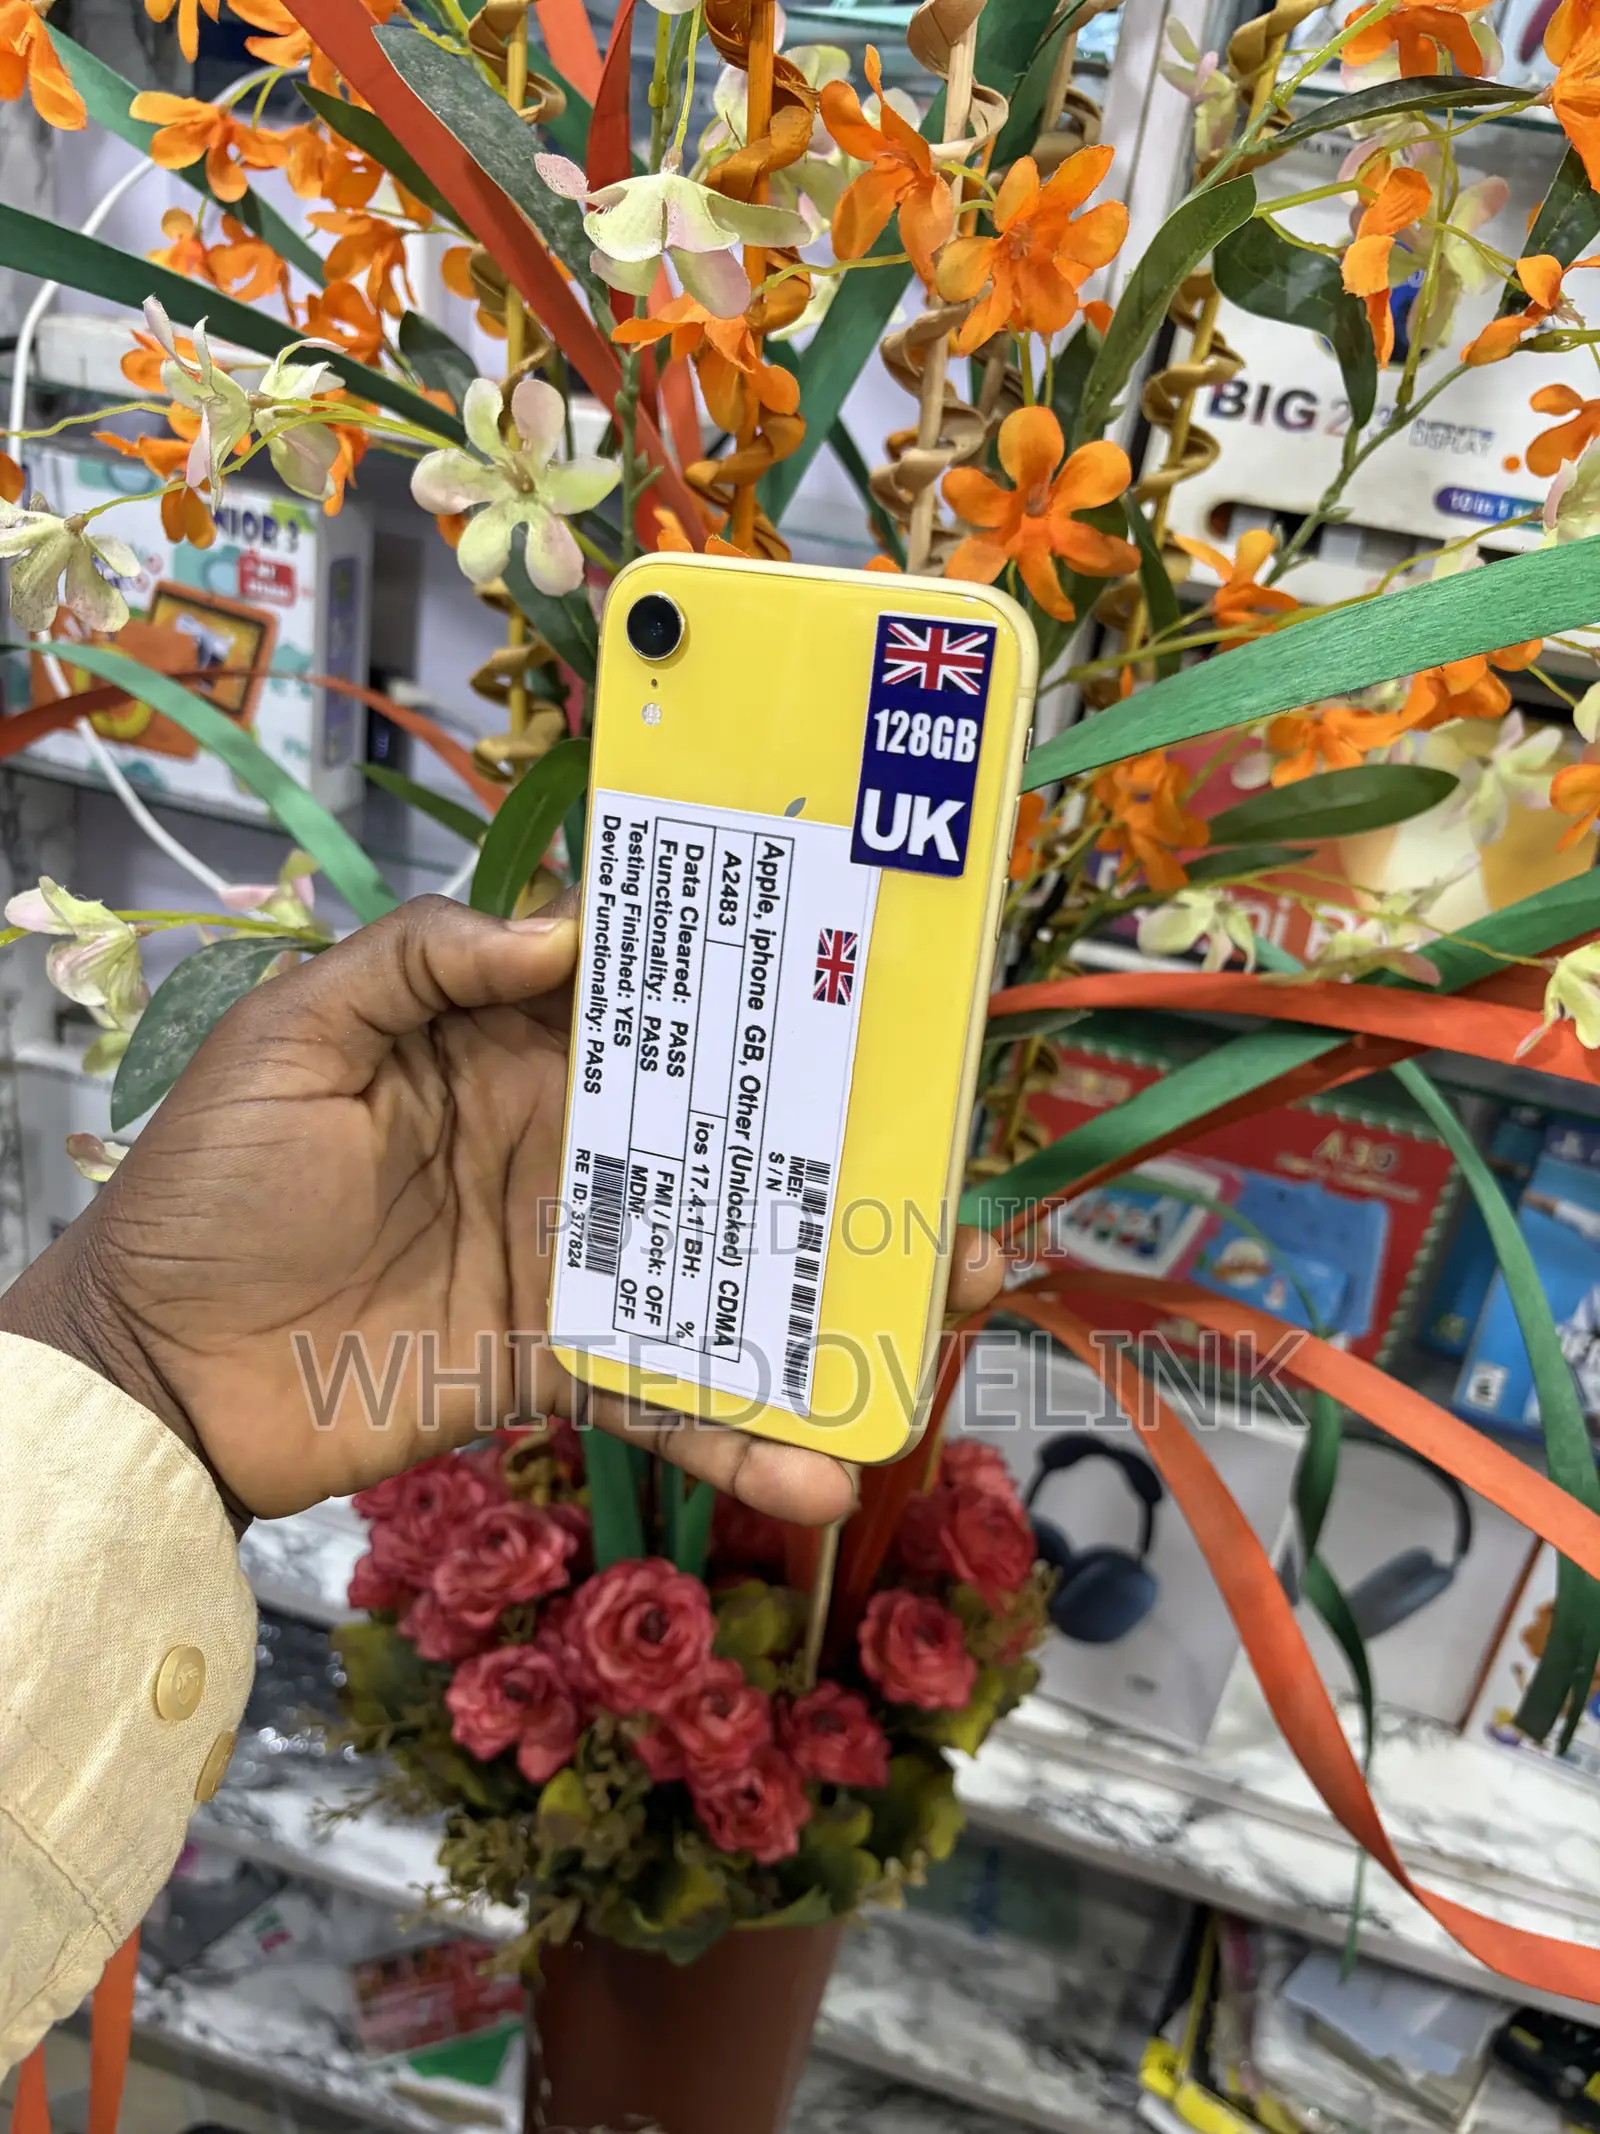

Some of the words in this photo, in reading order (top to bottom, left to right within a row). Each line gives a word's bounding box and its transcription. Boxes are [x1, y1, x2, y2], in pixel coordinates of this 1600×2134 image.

[1207, 378, 1319, 433] BIG
[874, 707, 978, 764] 128GB
[598, 814, 622, 886] Device
[860, 787, 966, 863] UK
[620, 819, 649, 897] Testing
[681, 843, 705, 898] Data
[753, 841, 786, 920] Apple,
[717, 850, 742, 927] A2483
[644, 839, 679, 1002] Functionality:
[584, 892, 616, 1033] Functionality:
[617, 902, 642, 999] Finished:
[672, 906, 700, 1004] Cleared:
[747, 927, 777, 1011] iphone
[613, 1006, 634, 1048] YES
[639, 1015, 662, 1072] PASS
[666, 1020, 689, 1078] PASS
[738, 1024, 767, 1066] GB,
[583, 1038, 605, 1095] PASS
[734, 1074, 762, 1141] Other
[574, 1148, 591, 1175] RE
[693, 1121, 715, 1155] ios
[572, 1182, 588, 1205] ID:
[627, 1164, 649, 1220] MDM:
[653, 1170, 675, 1208] FMI
[686, 1164, 711, 1227] 17.4.1
[786, 1155, 806, 1198] IMEI:
[716, 1145, 754, 1268] (Unlocked)
[567, 1210, 586, 1269] 377824
[647, 1221, 670, 1276] Lock:
[681, 1237, 704, 1279] BH:
[618, 1278, 638, 1320] OFF
[643, 1285, 664, 1327] OFF
[712, 1279, 740, 1347] CDMA
